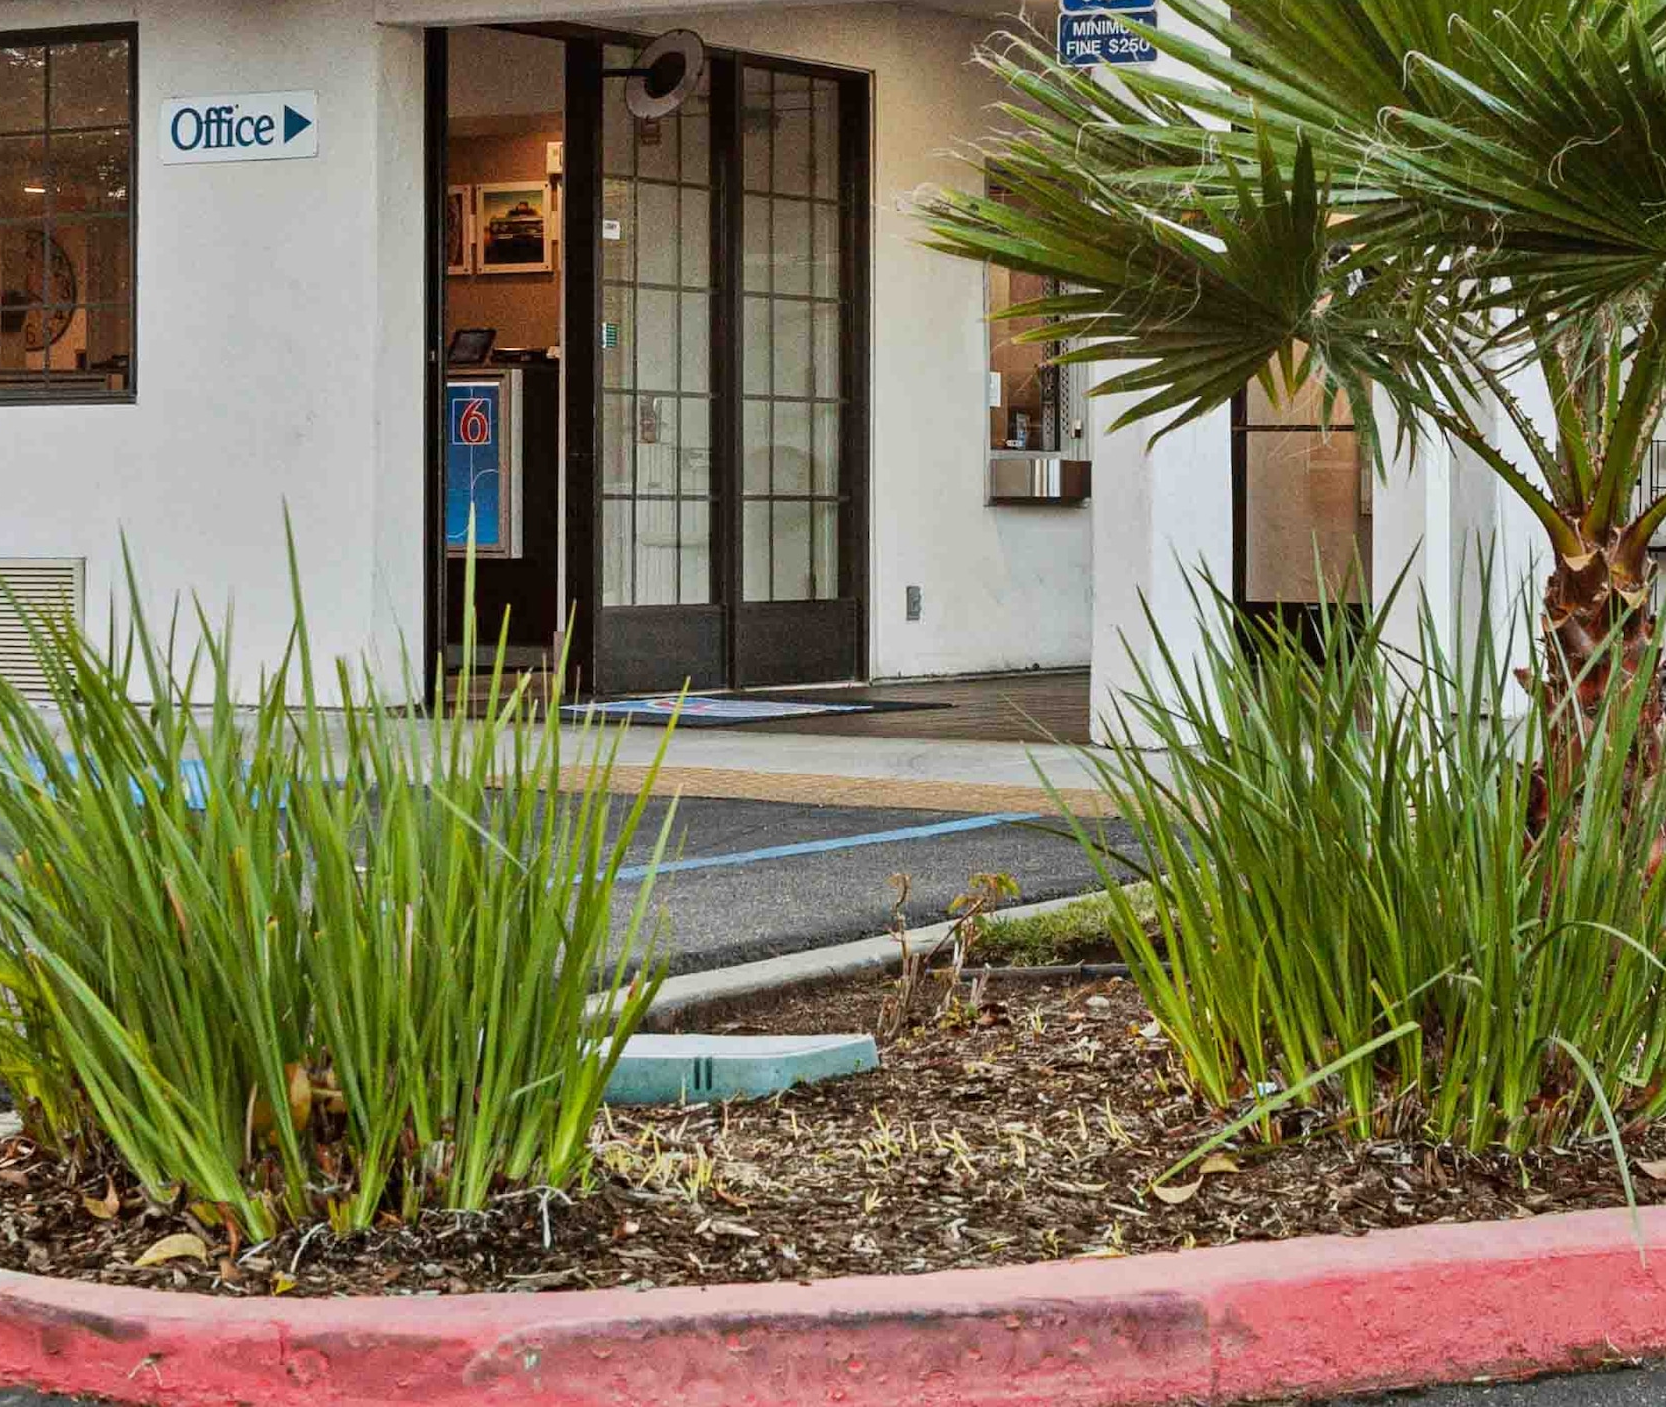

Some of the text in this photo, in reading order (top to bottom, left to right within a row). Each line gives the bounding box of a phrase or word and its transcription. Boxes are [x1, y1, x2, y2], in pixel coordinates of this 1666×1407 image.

[1073, 18, 1146, 36] MINIMU
[1066, 40, 1102, 55] FINE
[171, 104, 275, 151] Office
[460, 398, 488, 446] 6
